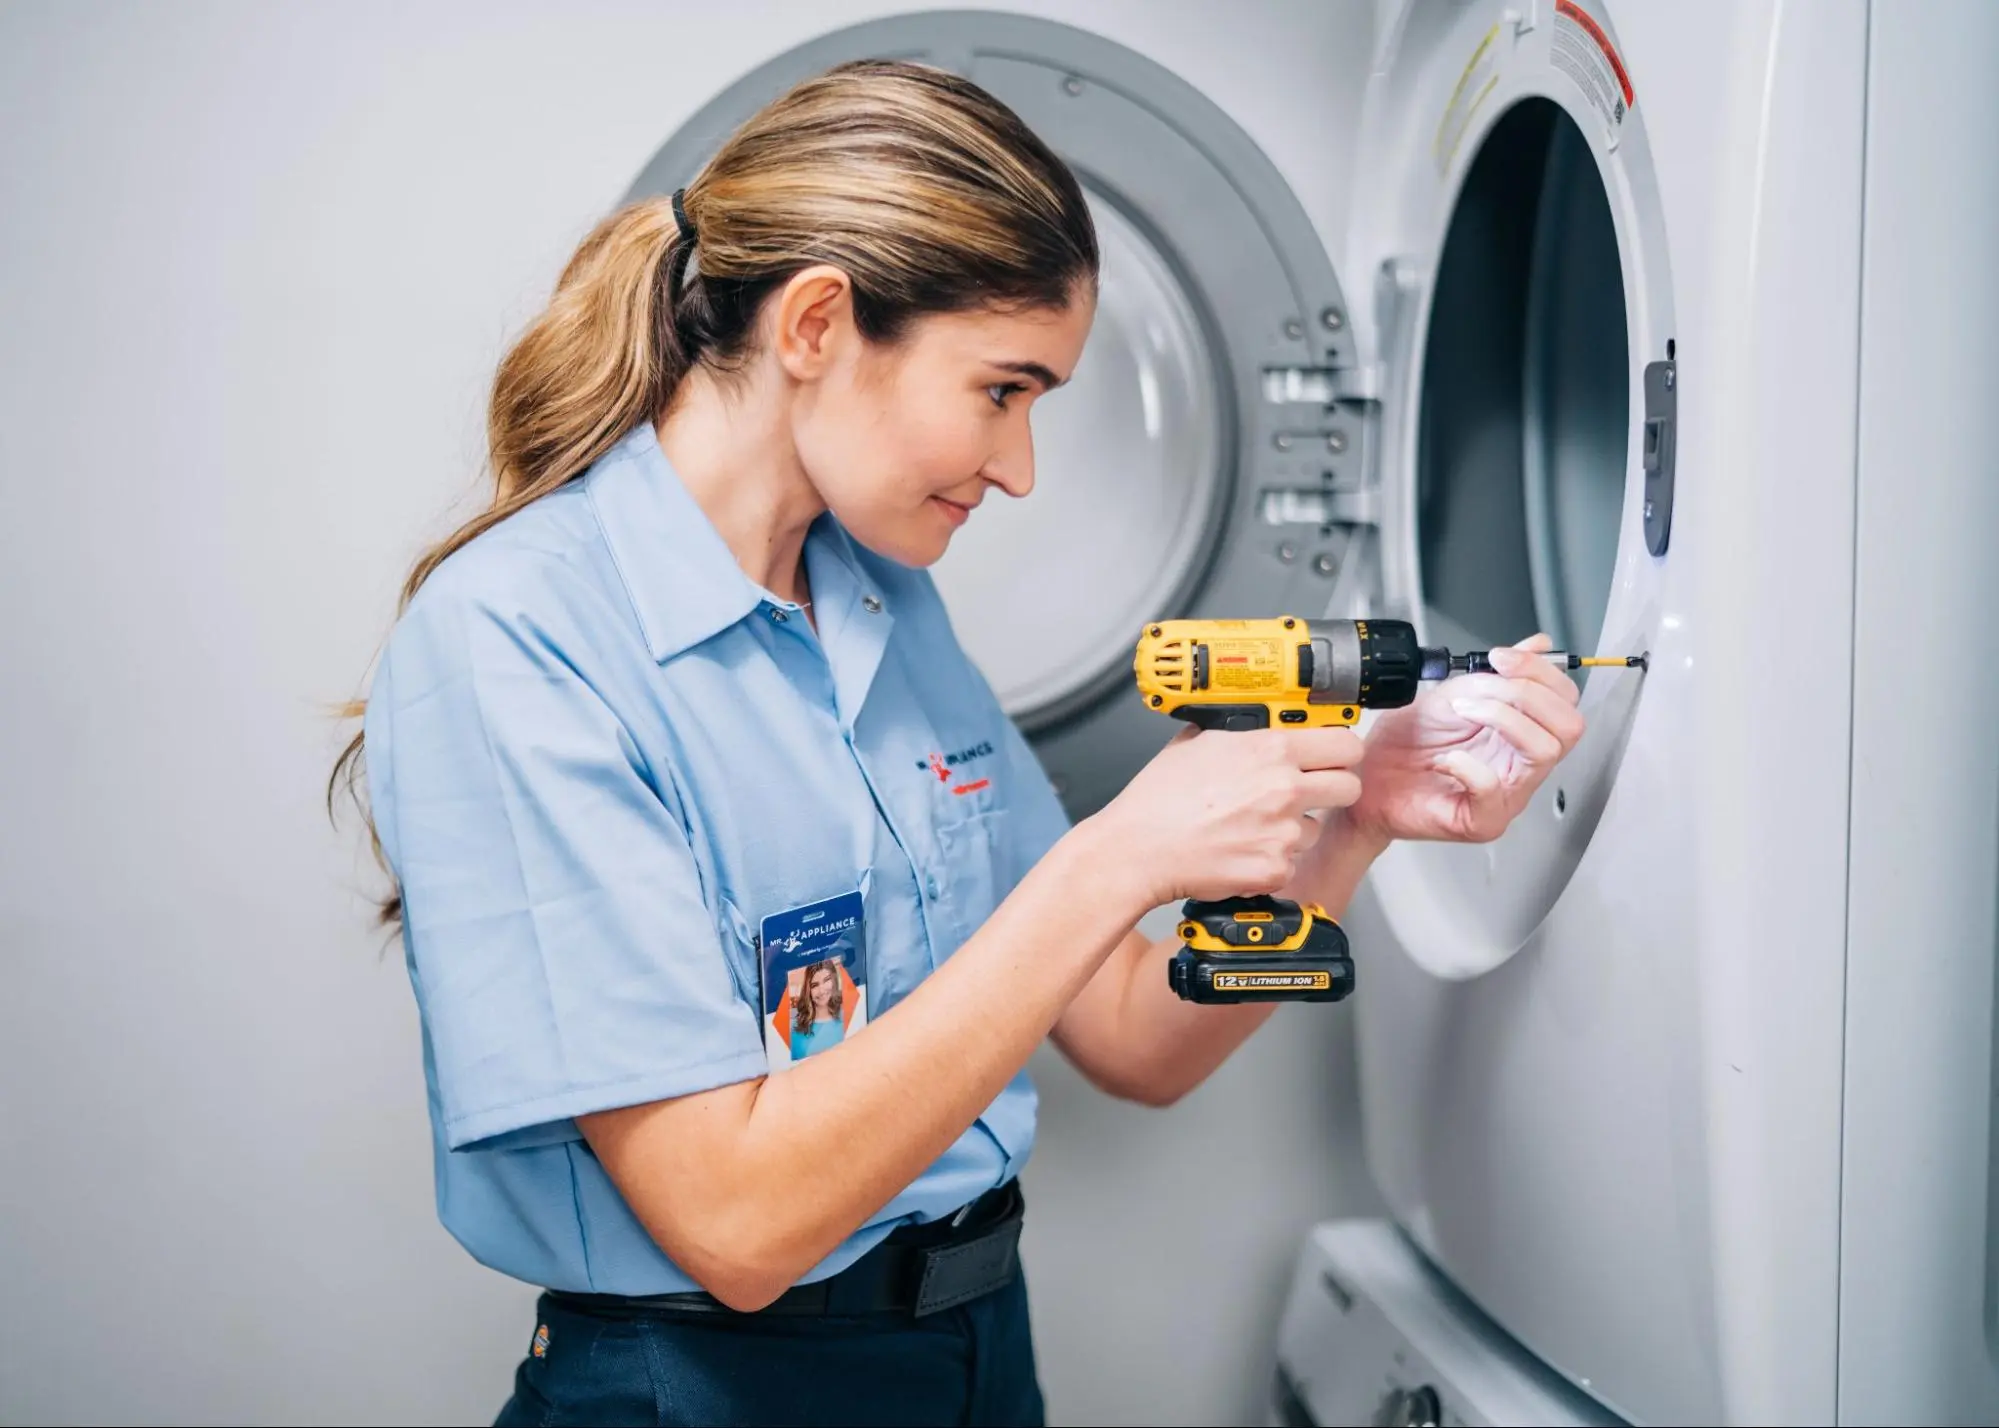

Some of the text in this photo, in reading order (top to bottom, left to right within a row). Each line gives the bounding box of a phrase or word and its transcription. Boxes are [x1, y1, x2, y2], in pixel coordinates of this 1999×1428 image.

[801, 917, 855, 939] APPLIANCE
[1251, 977, 1292, 985] LITHIUM
[1294, 977, 1312, 985] ION
